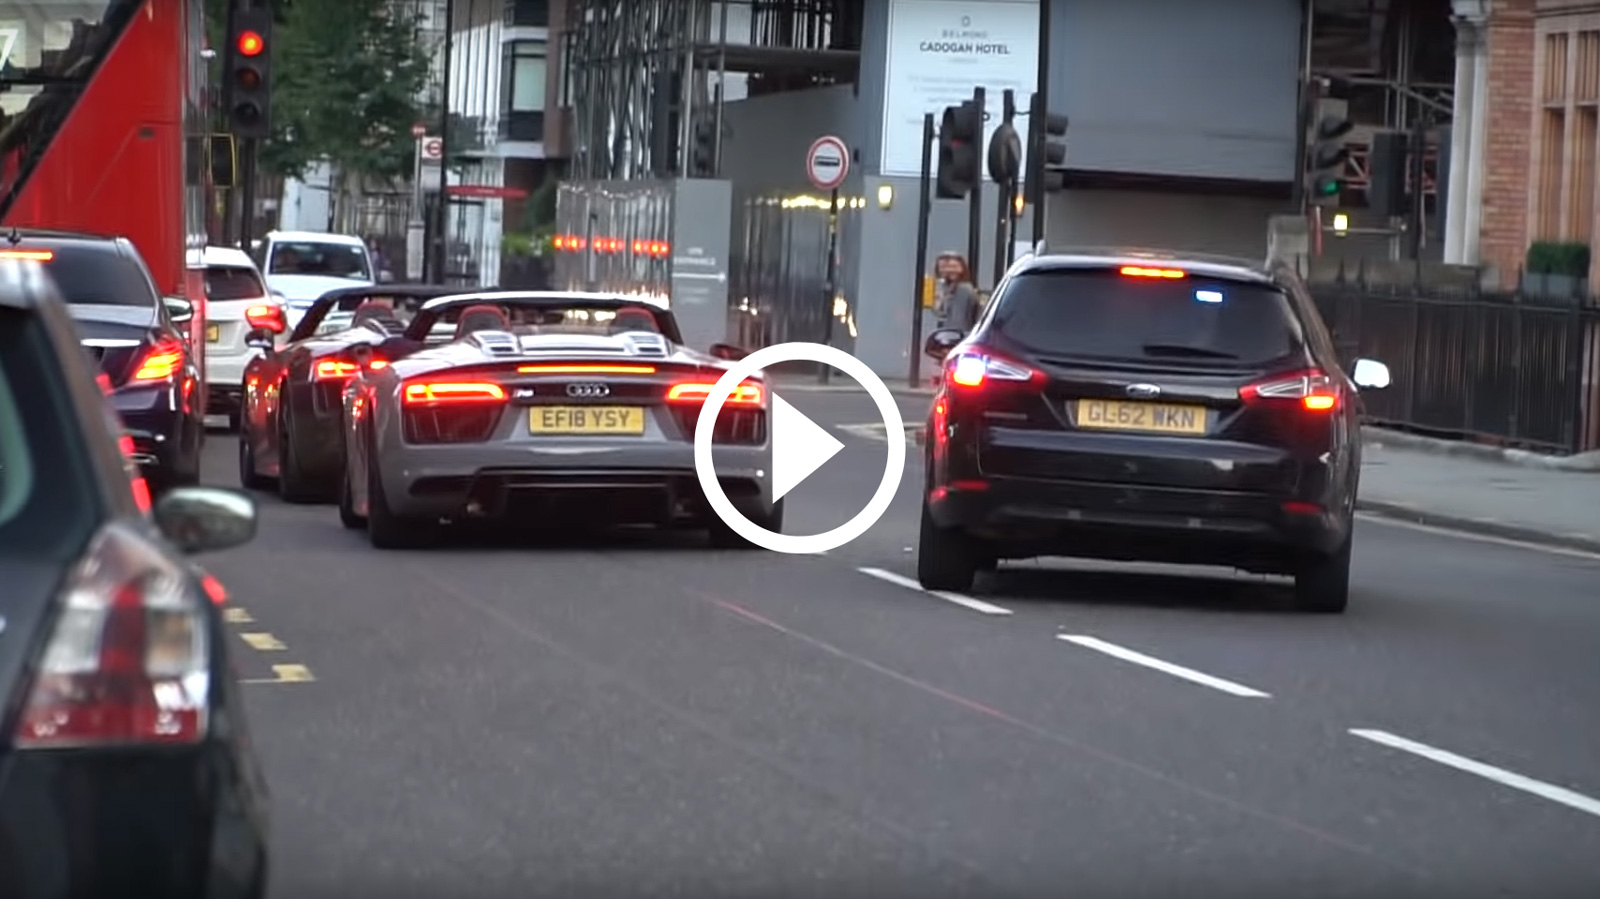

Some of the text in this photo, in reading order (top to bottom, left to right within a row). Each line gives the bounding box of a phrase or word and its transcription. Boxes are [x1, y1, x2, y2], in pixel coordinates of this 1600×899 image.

[919, 42, 1009, 54] CADOGAN HOTEL
[542, 409, 630, 428] EF18 YSY
[1088, 401, 1196, 428] GL62 WKN
